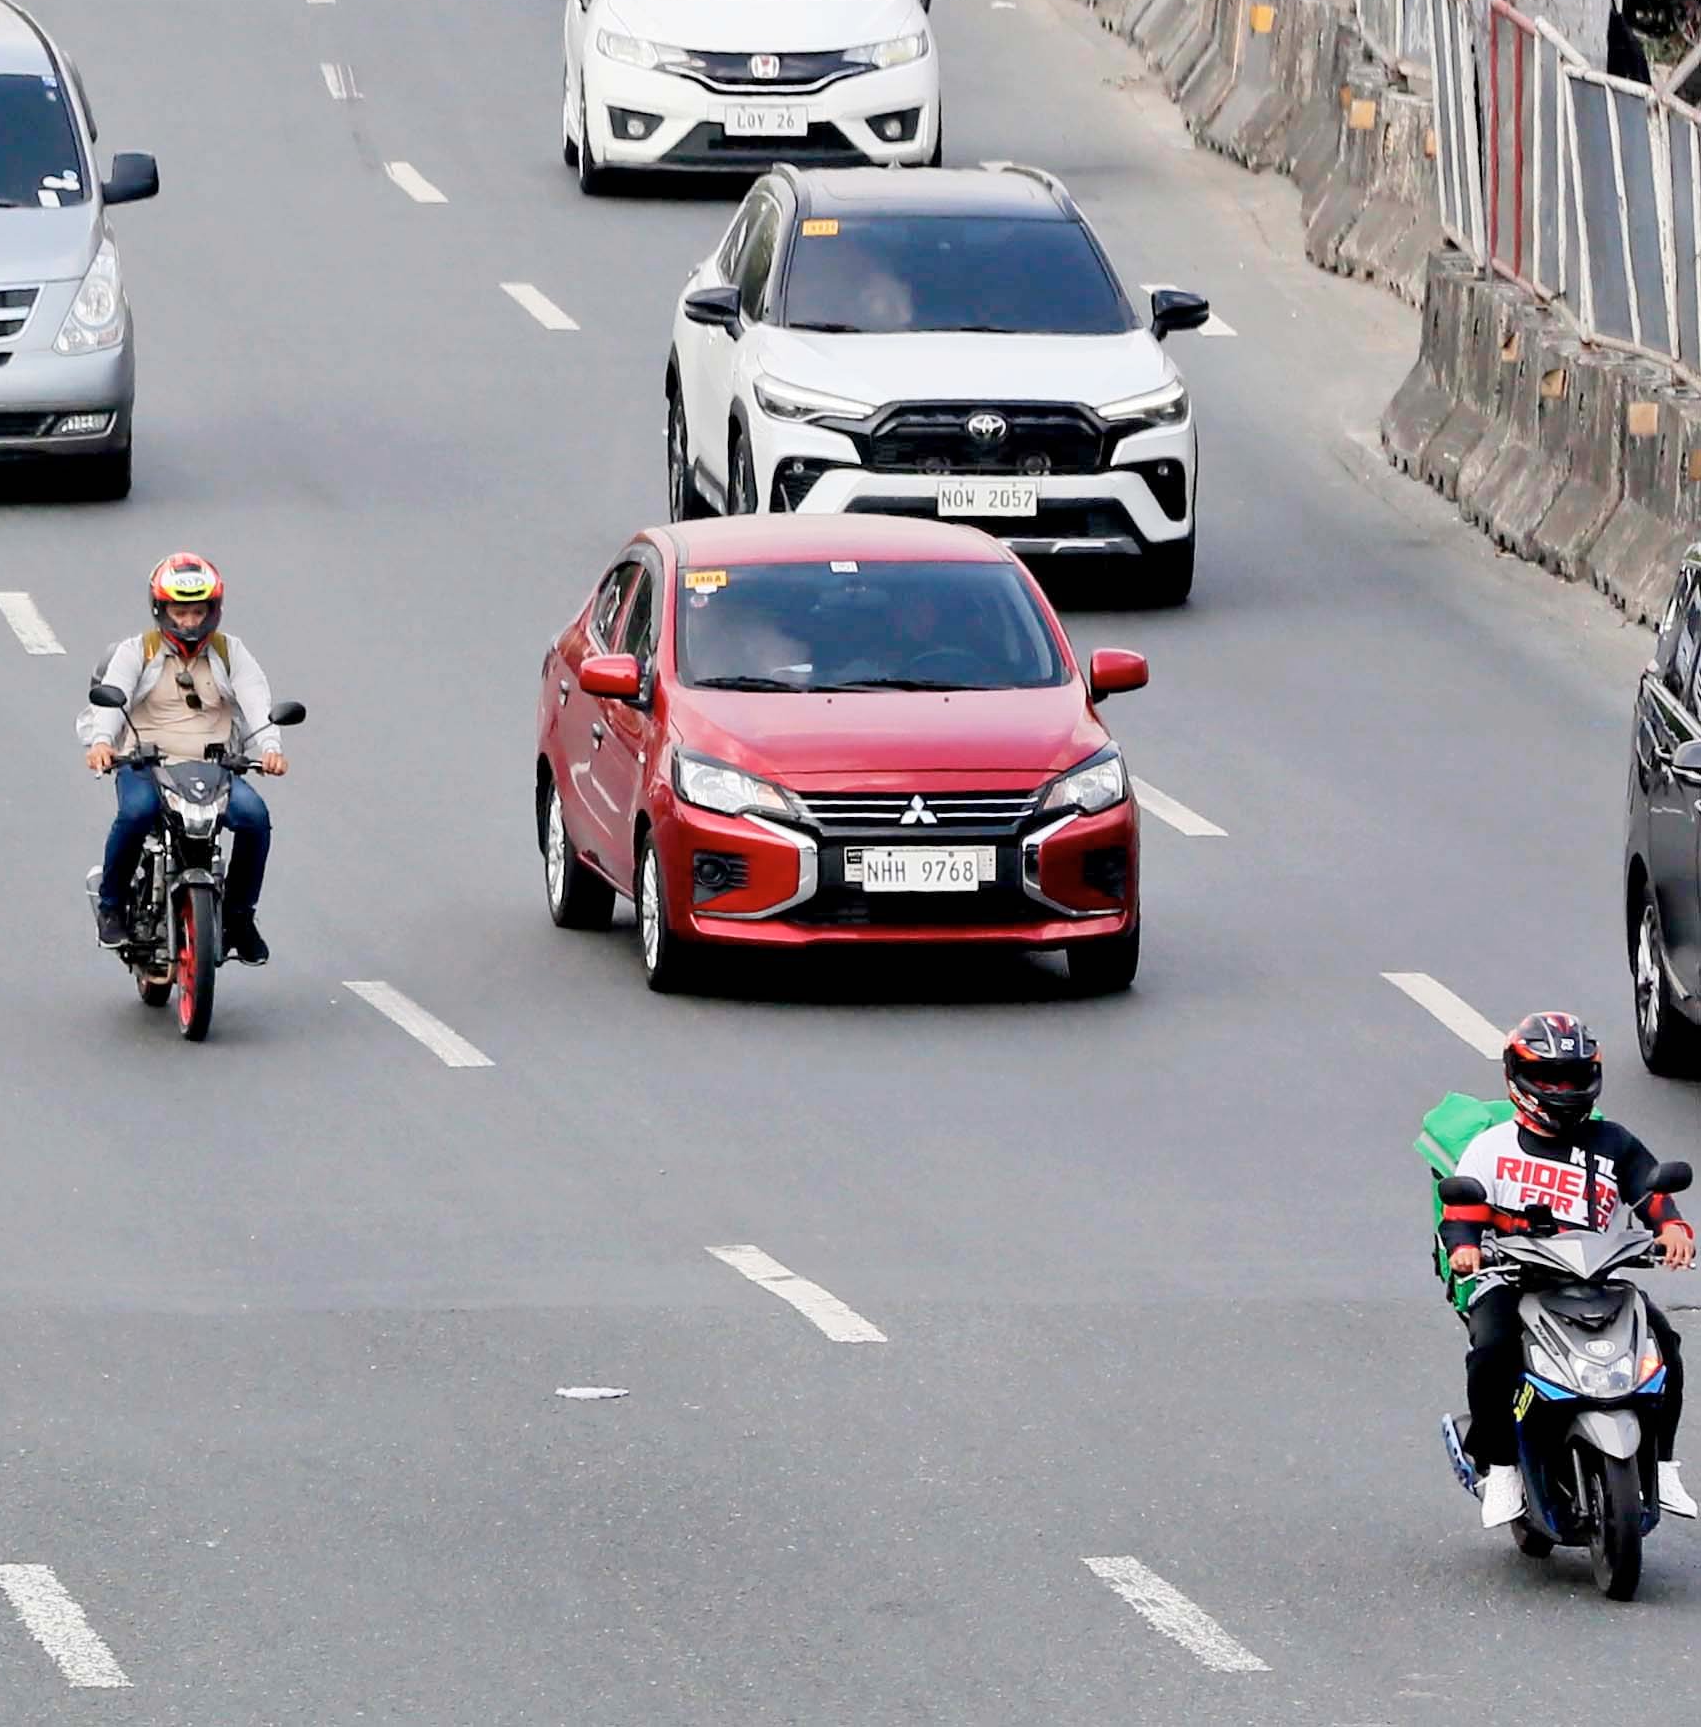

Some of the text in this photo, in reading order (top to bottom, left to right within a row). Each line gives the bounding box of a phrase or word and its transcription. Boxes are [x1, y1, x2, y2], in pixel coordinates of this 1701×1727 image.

[777, 113, 795, 130] 26
[941, 490, 1033, 508] NOW 2057
[867, 860, 974, 882] NHH 9768
